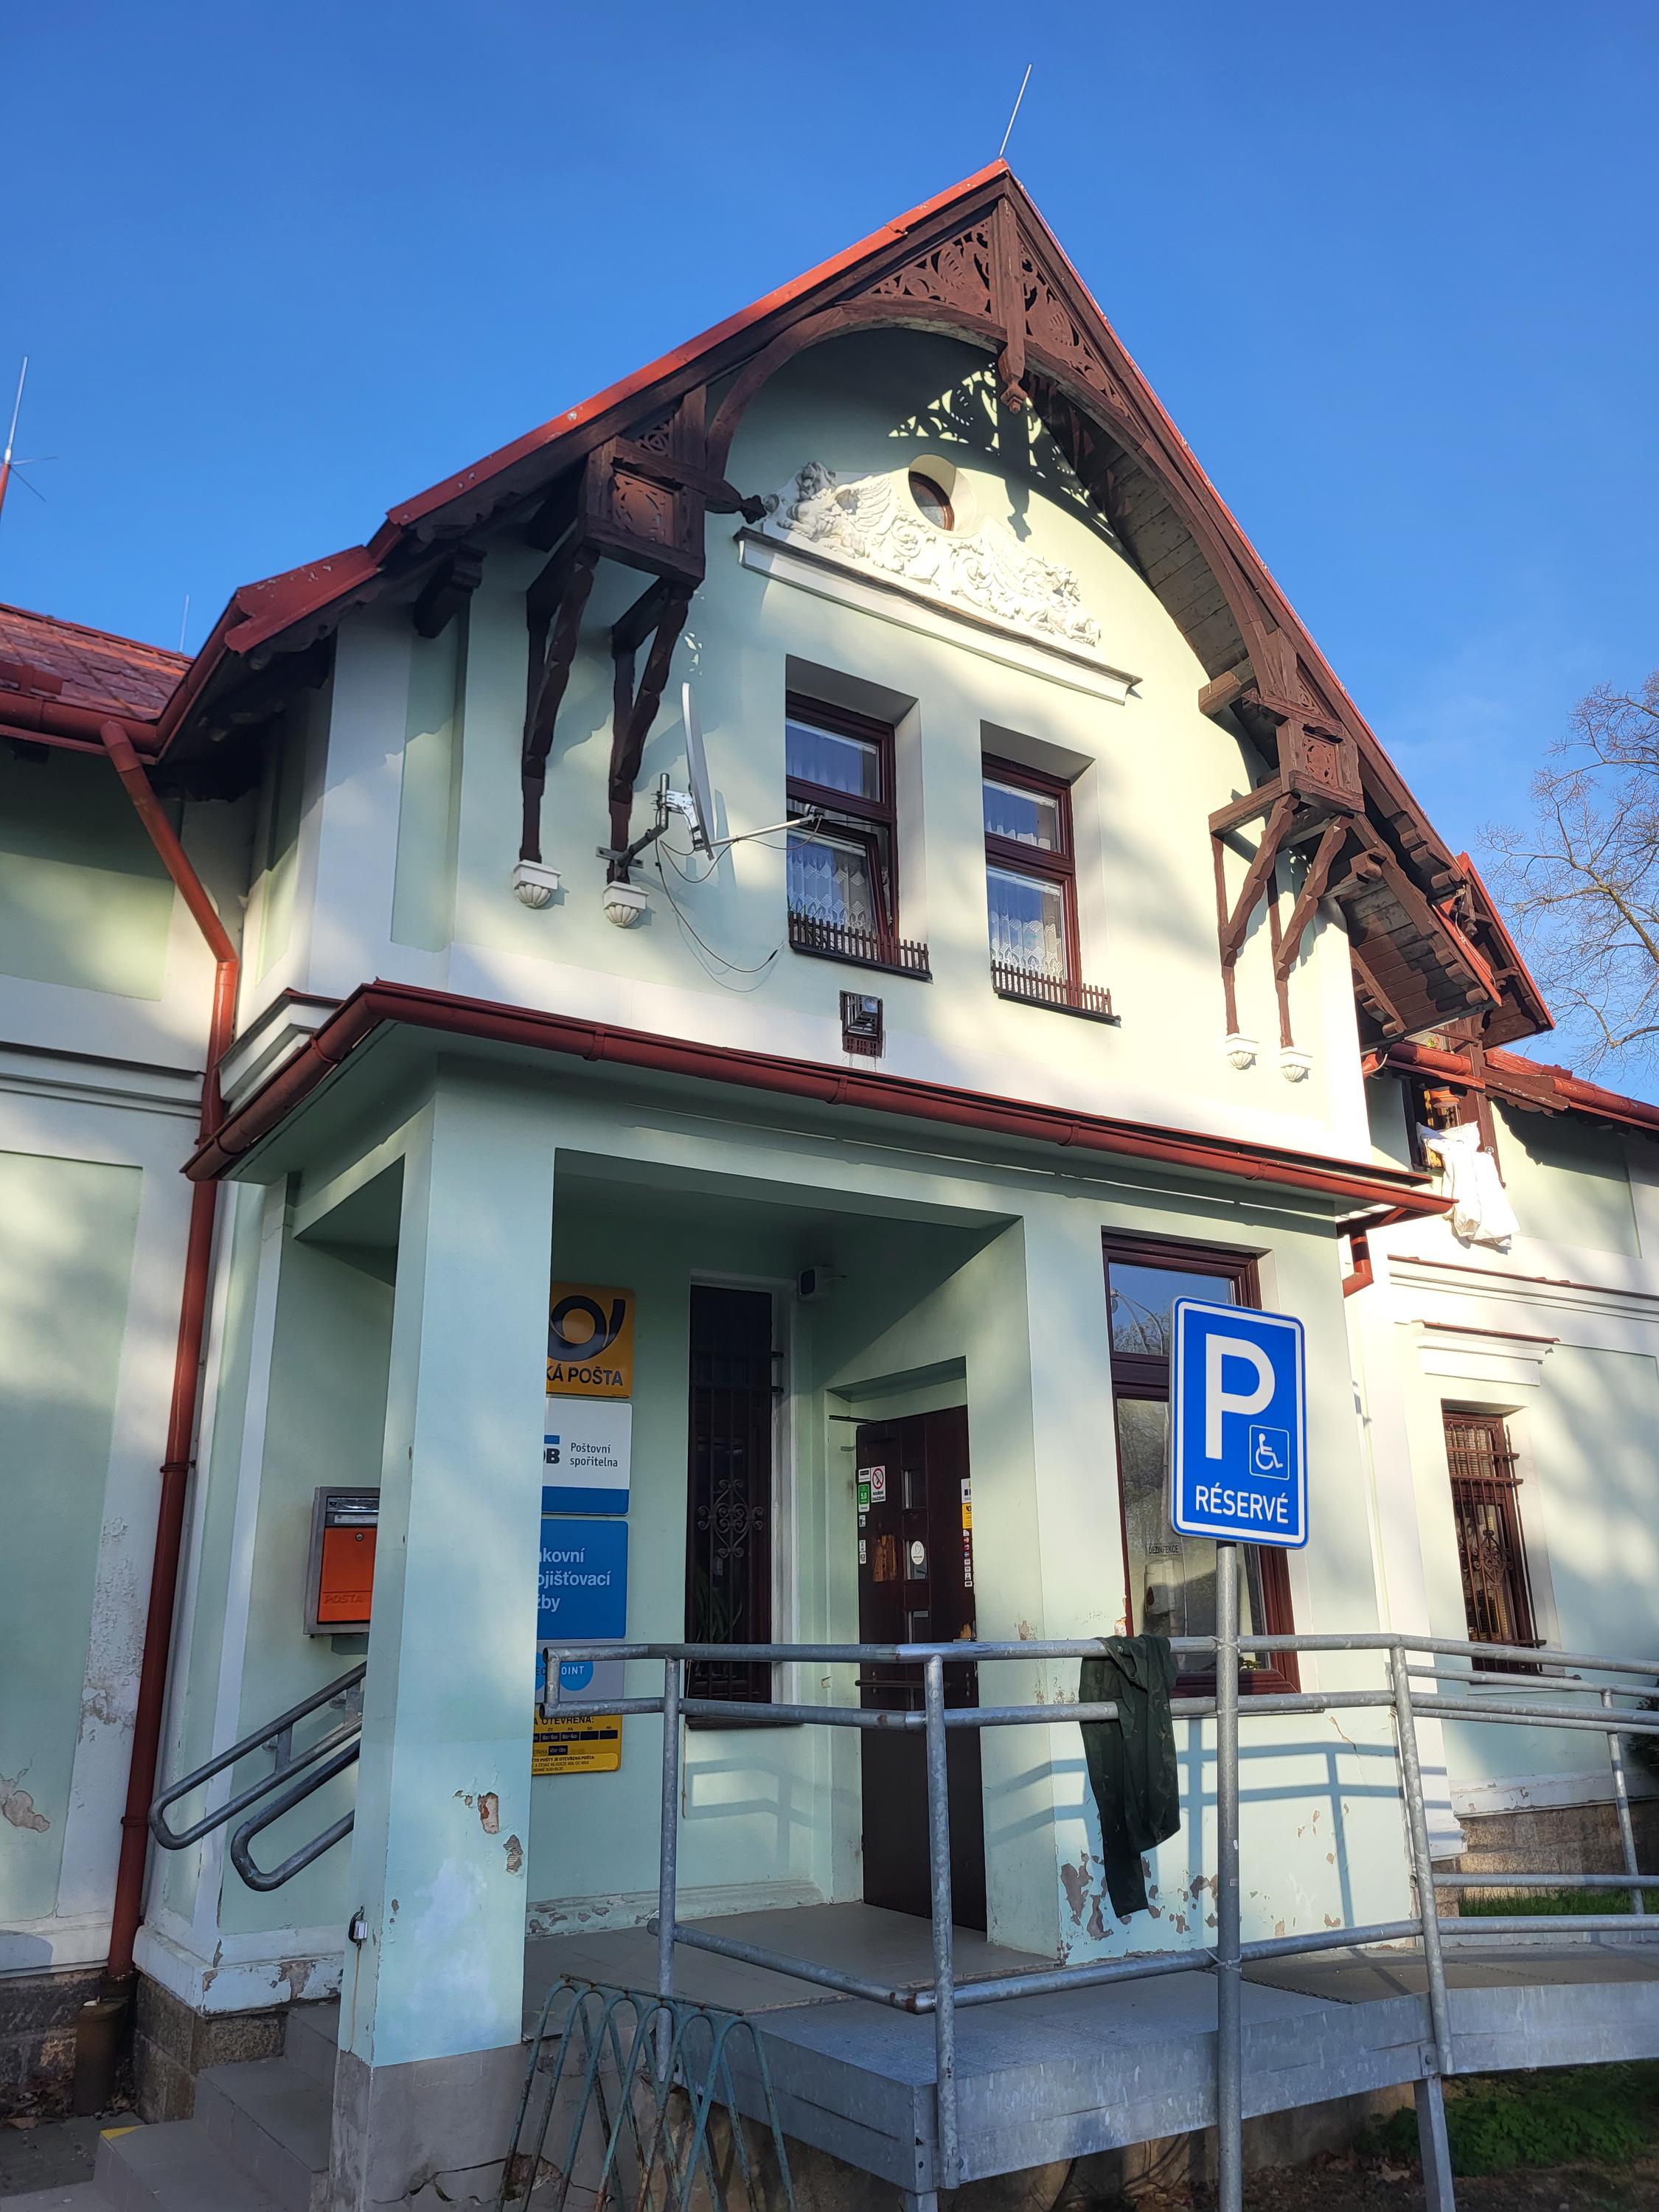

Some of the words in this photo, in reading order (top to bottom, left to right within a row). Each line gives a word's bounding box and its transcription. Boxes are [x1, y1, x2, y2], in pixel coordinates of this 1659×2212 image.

[567, 1366, 624, 1386] POŠTA
[1206, 1333, 1276, 1460] P
[543, 1447, 560, 1464] B
[570, 1442, 611, 1454] Poštovní
[569, 1456, 618, 1468] spořitelna
[1195, 1482, 1289, 1523] RÉSERVÉ
[538, 1570, 612, 1589] ojišťovací
